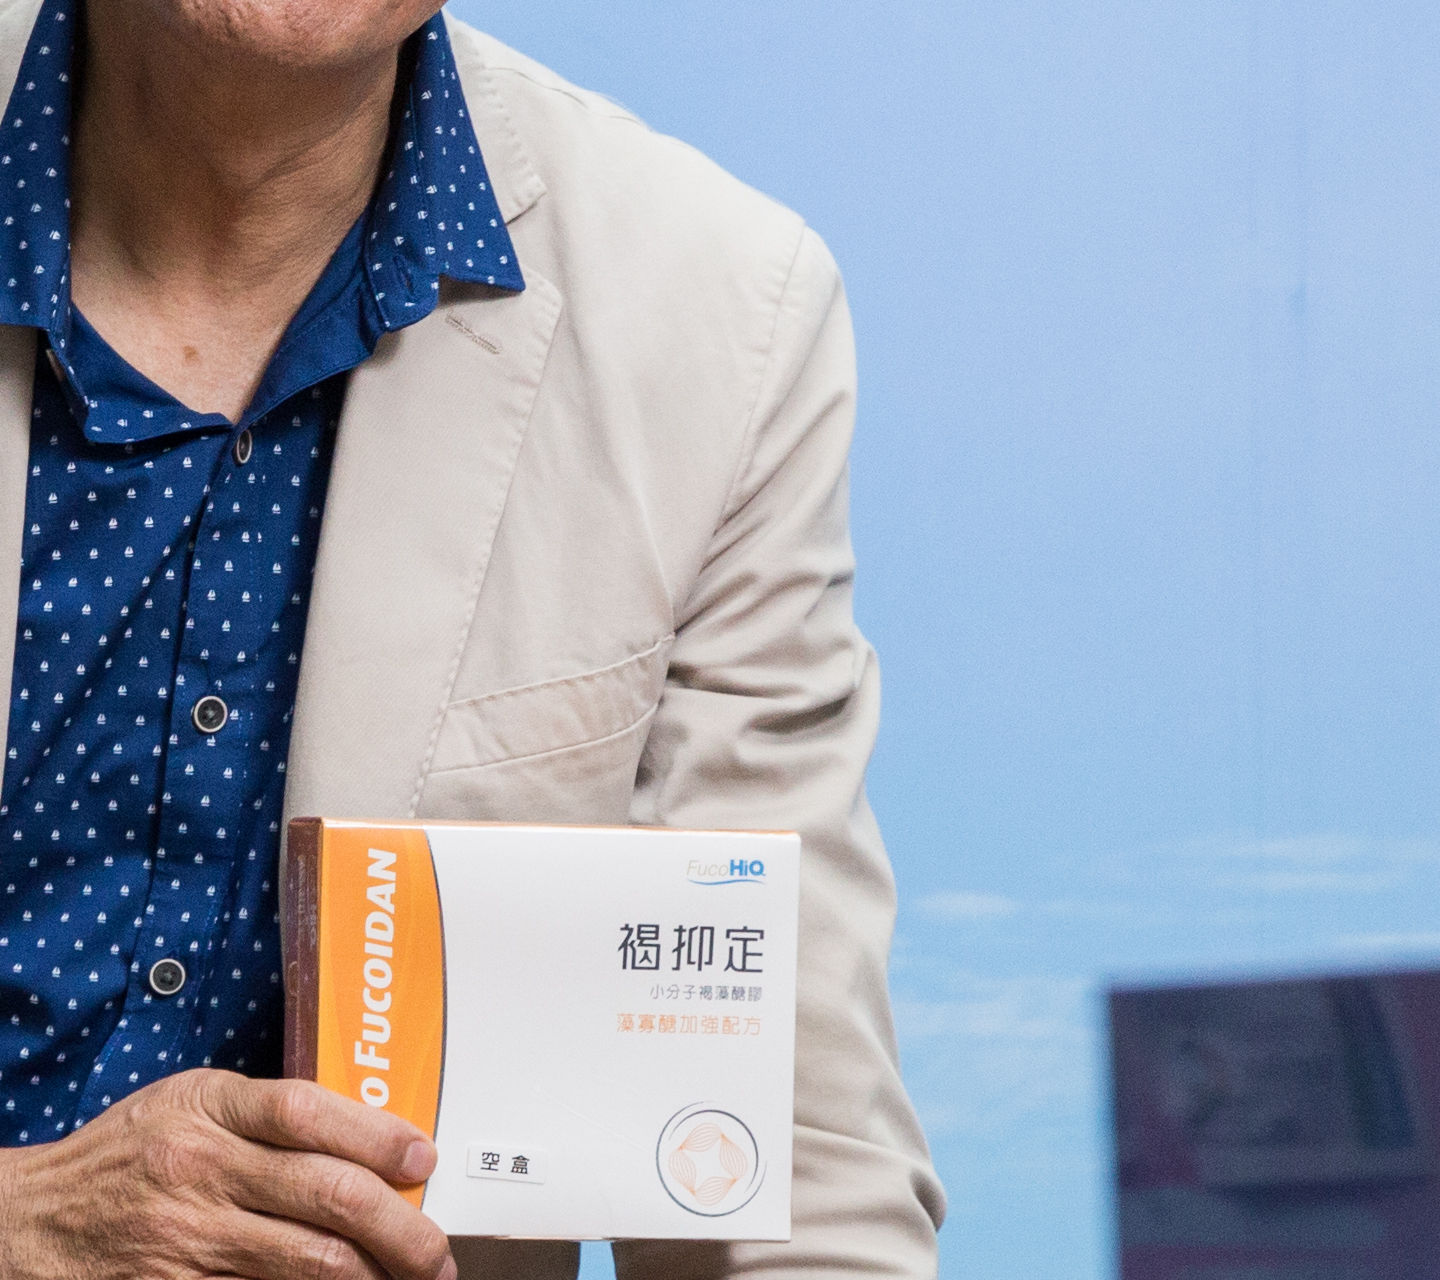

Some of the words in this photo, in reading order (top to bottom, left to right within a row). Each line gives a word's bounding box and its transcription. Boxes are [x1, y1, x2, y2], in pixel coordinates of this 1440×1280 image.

[686, 859, 766, 877] FucoHiQ
[354, 847, 398, 1071] FUCOIDAN
[617, 923, 765, 973] 褐抑定
[650, 983, 763, 1002] 小分子褐藻醣膠
[616, 1012, 763, 1036] 藻寡醣加強配方
